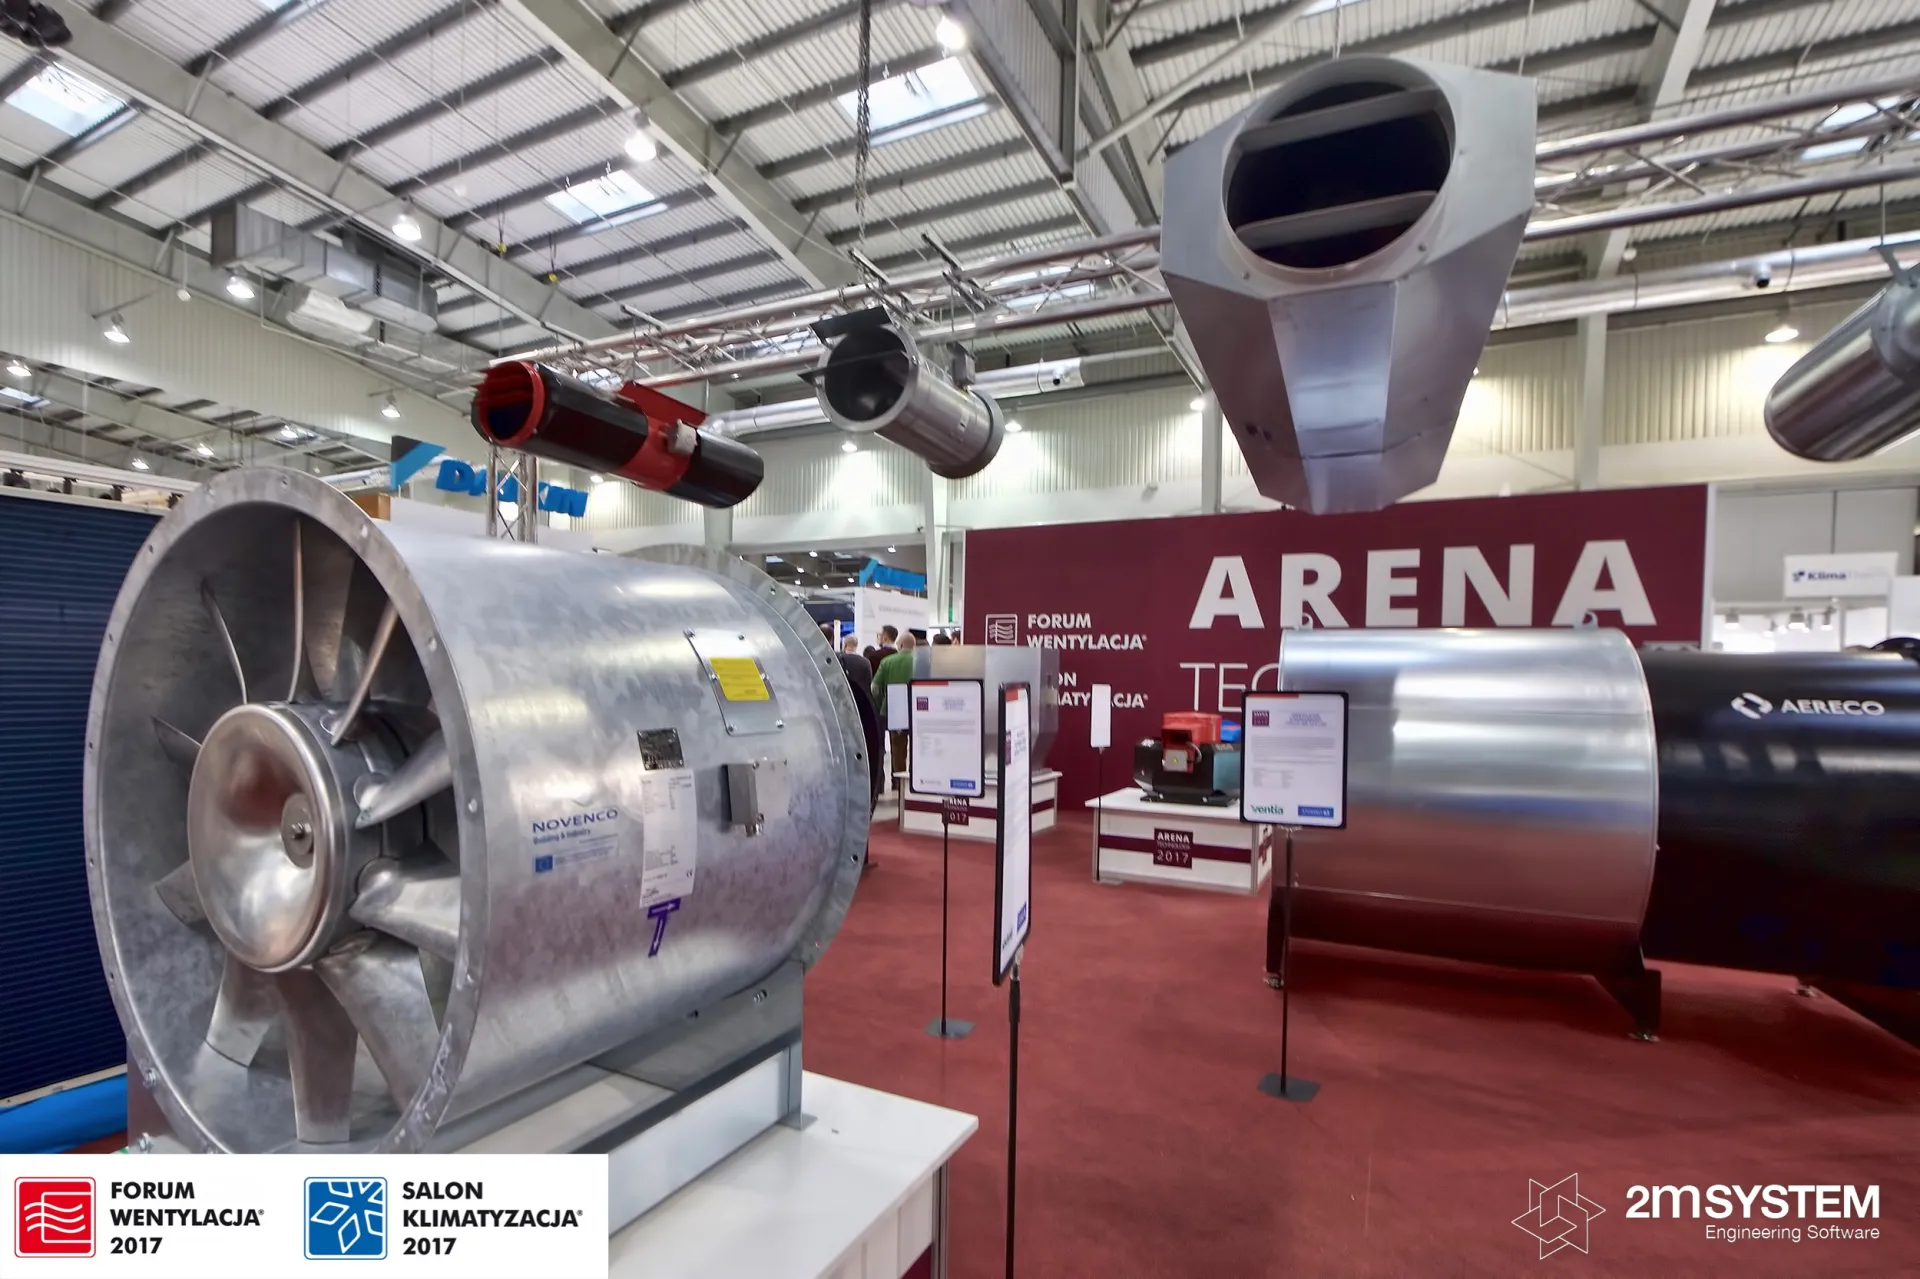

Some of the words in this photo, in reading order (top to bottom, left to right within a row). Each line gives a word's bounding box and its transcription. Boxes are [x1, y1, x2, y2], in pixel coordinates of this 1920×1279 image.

[1188, 540, 1658, 628] ARENA
[1027, 613, 1091, 629] FORUM
[1781, 699, 1885, 716] AERECO
[949, 810, 967, 823] 017
[1251, 804, 1284, 815] ventia
[532, 808, 618, 833] NOVENCO
[1157, 831, 1190, 844] ARENA
[1157, 849, 1189, 864] 2017
